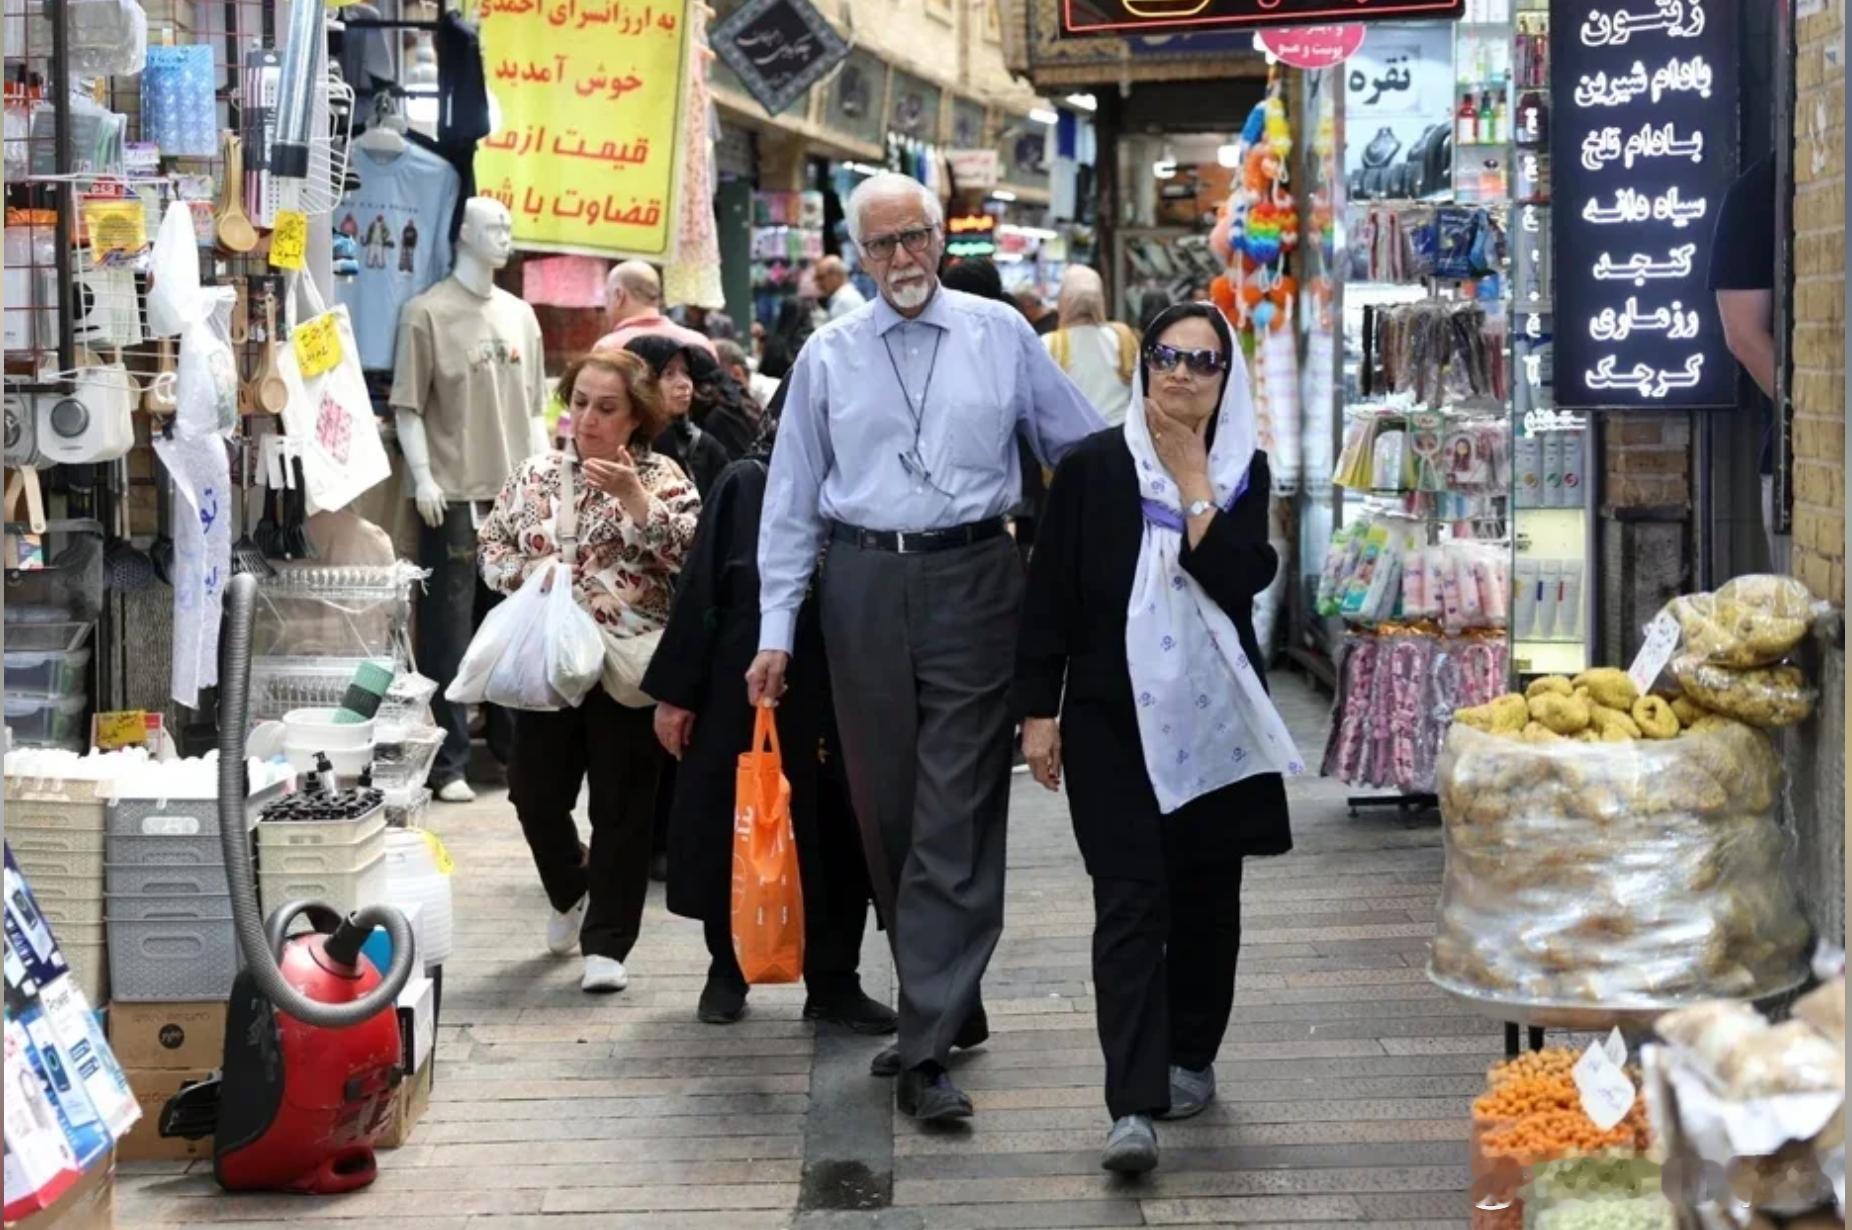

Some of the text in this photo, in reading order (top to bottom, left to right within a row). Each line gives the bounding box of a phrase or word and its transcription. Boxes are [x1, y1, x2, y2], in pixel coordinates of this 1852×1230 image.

[657, 13, 676, 38] به
[1580, 0, 1705, 46] زیتون
[495, 54, 643, 100] خوش آمدید
[1349, 56, 1411, 105] نقره
[1574, 54, 1712, 107] بادام شیرین
[552, 128, 650, 171] قیمت
[1581, 122, 1703, 171] بادام تلخ
[523, 186, 544, 223] با
[552, 188, 662, 227] قضاوت
[1582, 186, 1707, 228] سیاه دانه
[1592, 243, 1696, 286] کنجد
[1589, 295, 1699, 341] رزماری
[1585, 352, 1704, 398] کرچک
